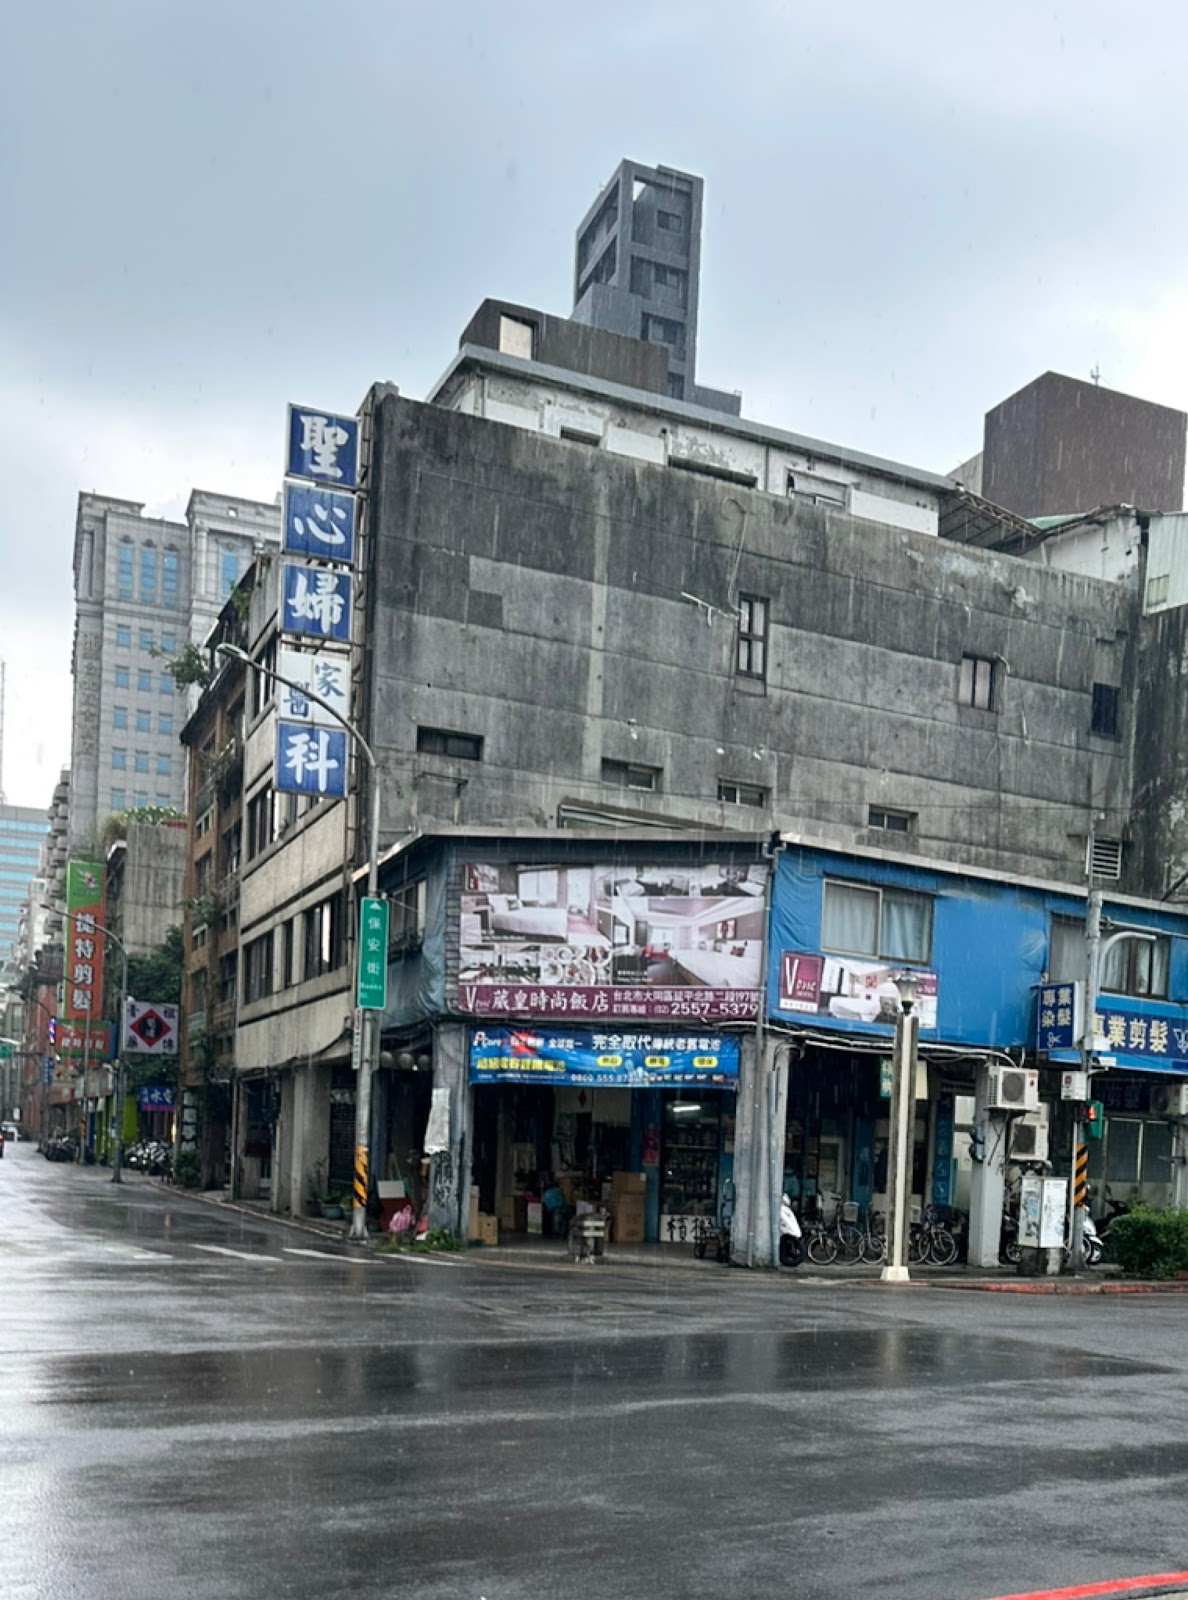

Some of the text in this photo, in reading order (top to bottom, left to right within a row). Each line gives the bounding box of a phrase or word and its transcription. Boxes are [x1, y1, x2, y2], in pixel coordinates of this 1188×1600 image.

[367, 917, 382, 975] 保安街
[671, 1003, 758, 1016] 2557-5379
